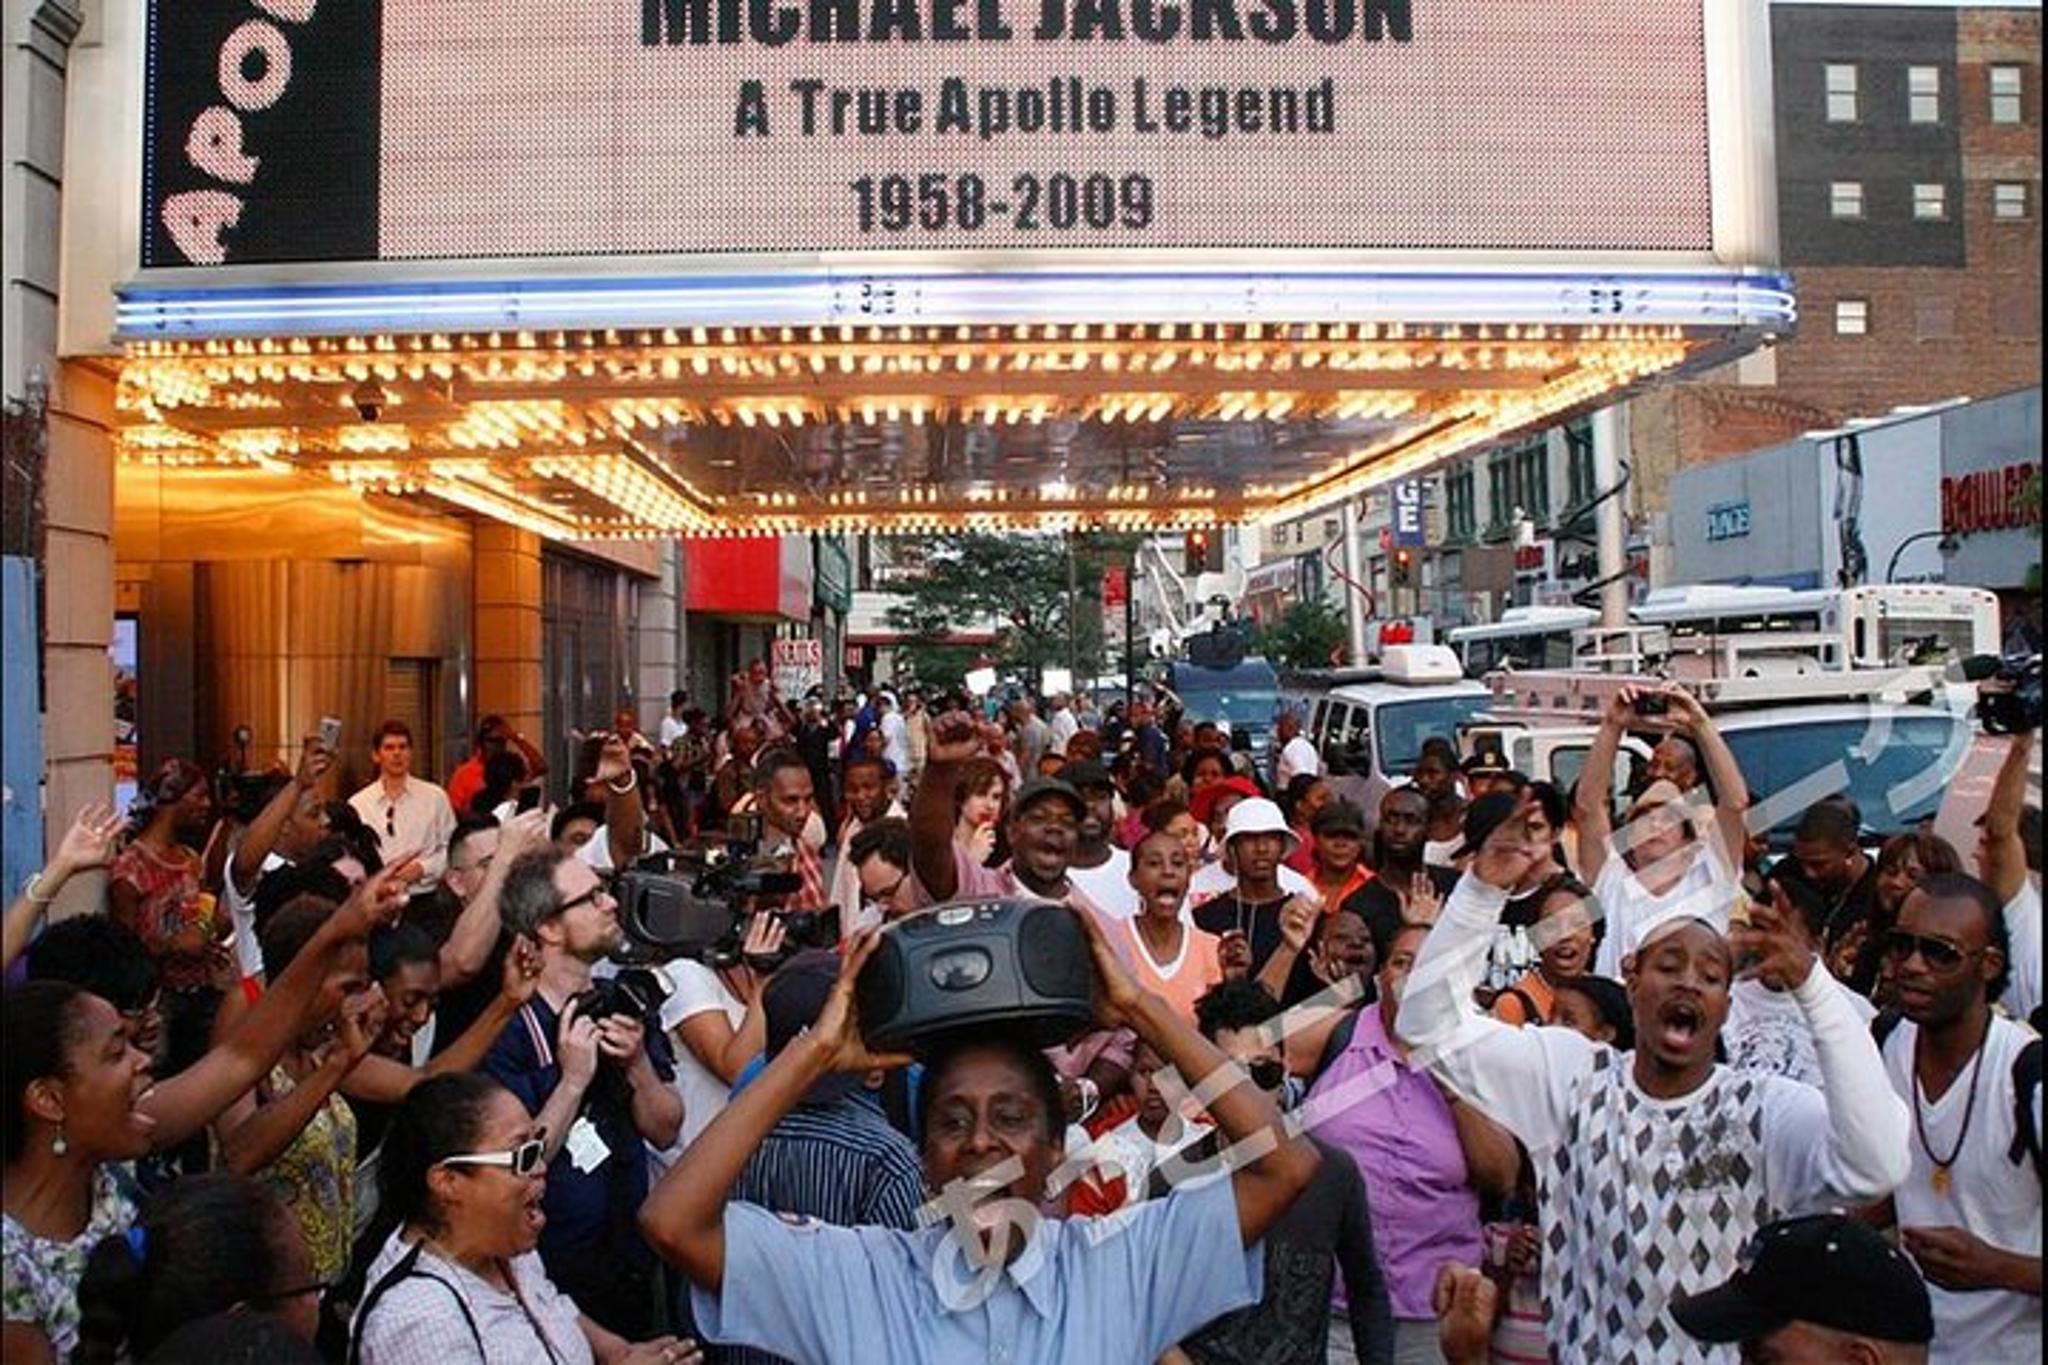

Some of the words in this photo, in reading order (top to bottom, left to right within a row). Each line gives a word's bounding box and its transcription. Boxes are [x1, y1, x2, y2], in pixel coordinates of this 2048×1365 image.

[161, 0, 317, 266] APO
[734, 78, 770, 138] A
[789, 78, 922, 137] True
[935, 76, 1116, 141] Apollo
[1132, 75, 1336, 140] Legend
[850, 172, 1154, 233] 1958-2009
